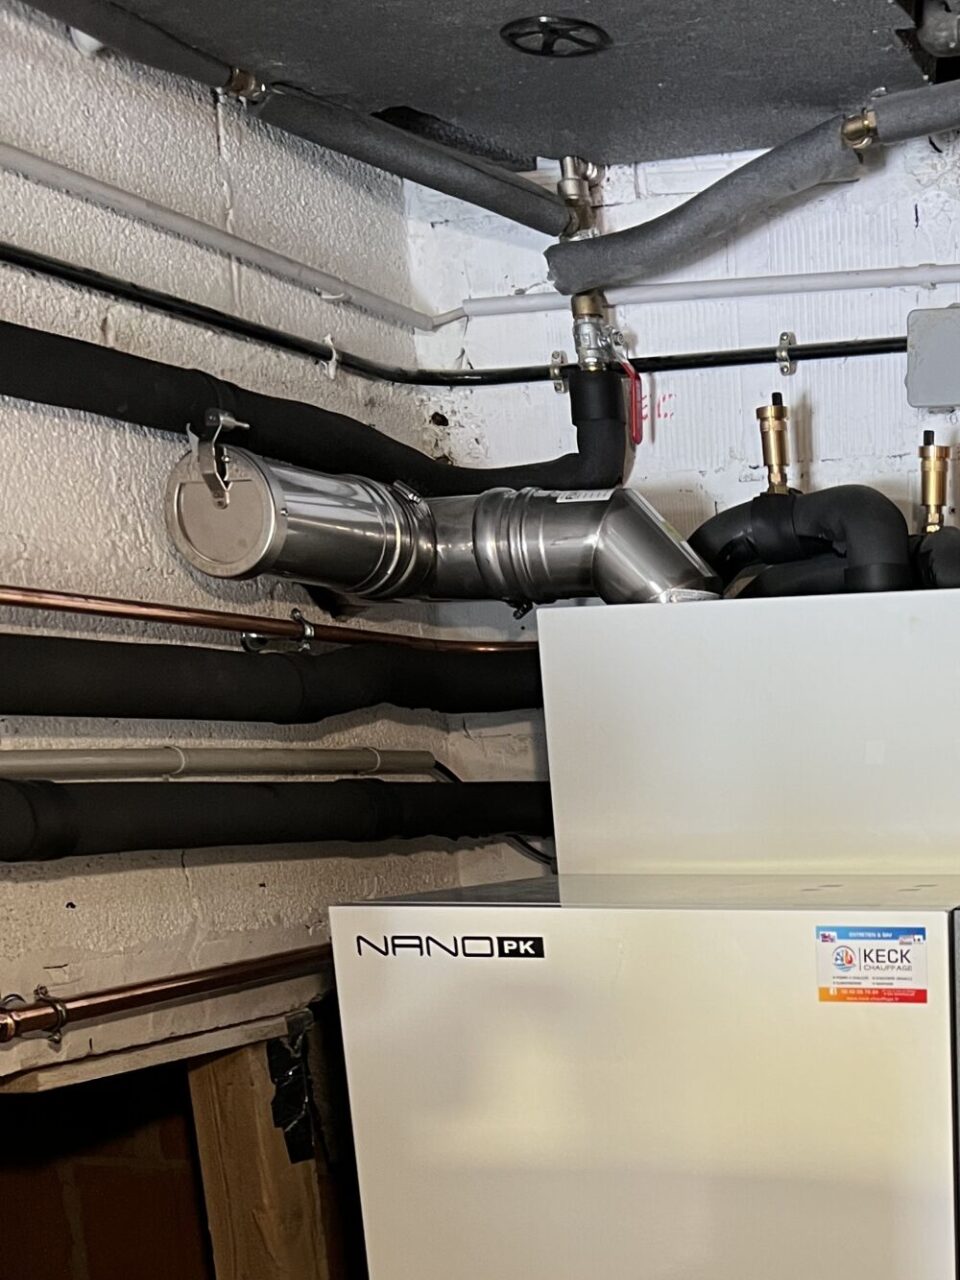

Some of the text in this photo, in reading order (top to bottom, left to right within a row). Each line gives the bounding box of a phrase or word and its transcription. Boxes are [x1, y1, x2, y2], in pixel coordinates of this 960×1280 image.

[356, 935, 536, 958] NANO PK
[863, 948, 911, 964] KECK
[863, 964, 912, 972] CHAUFFAGE
